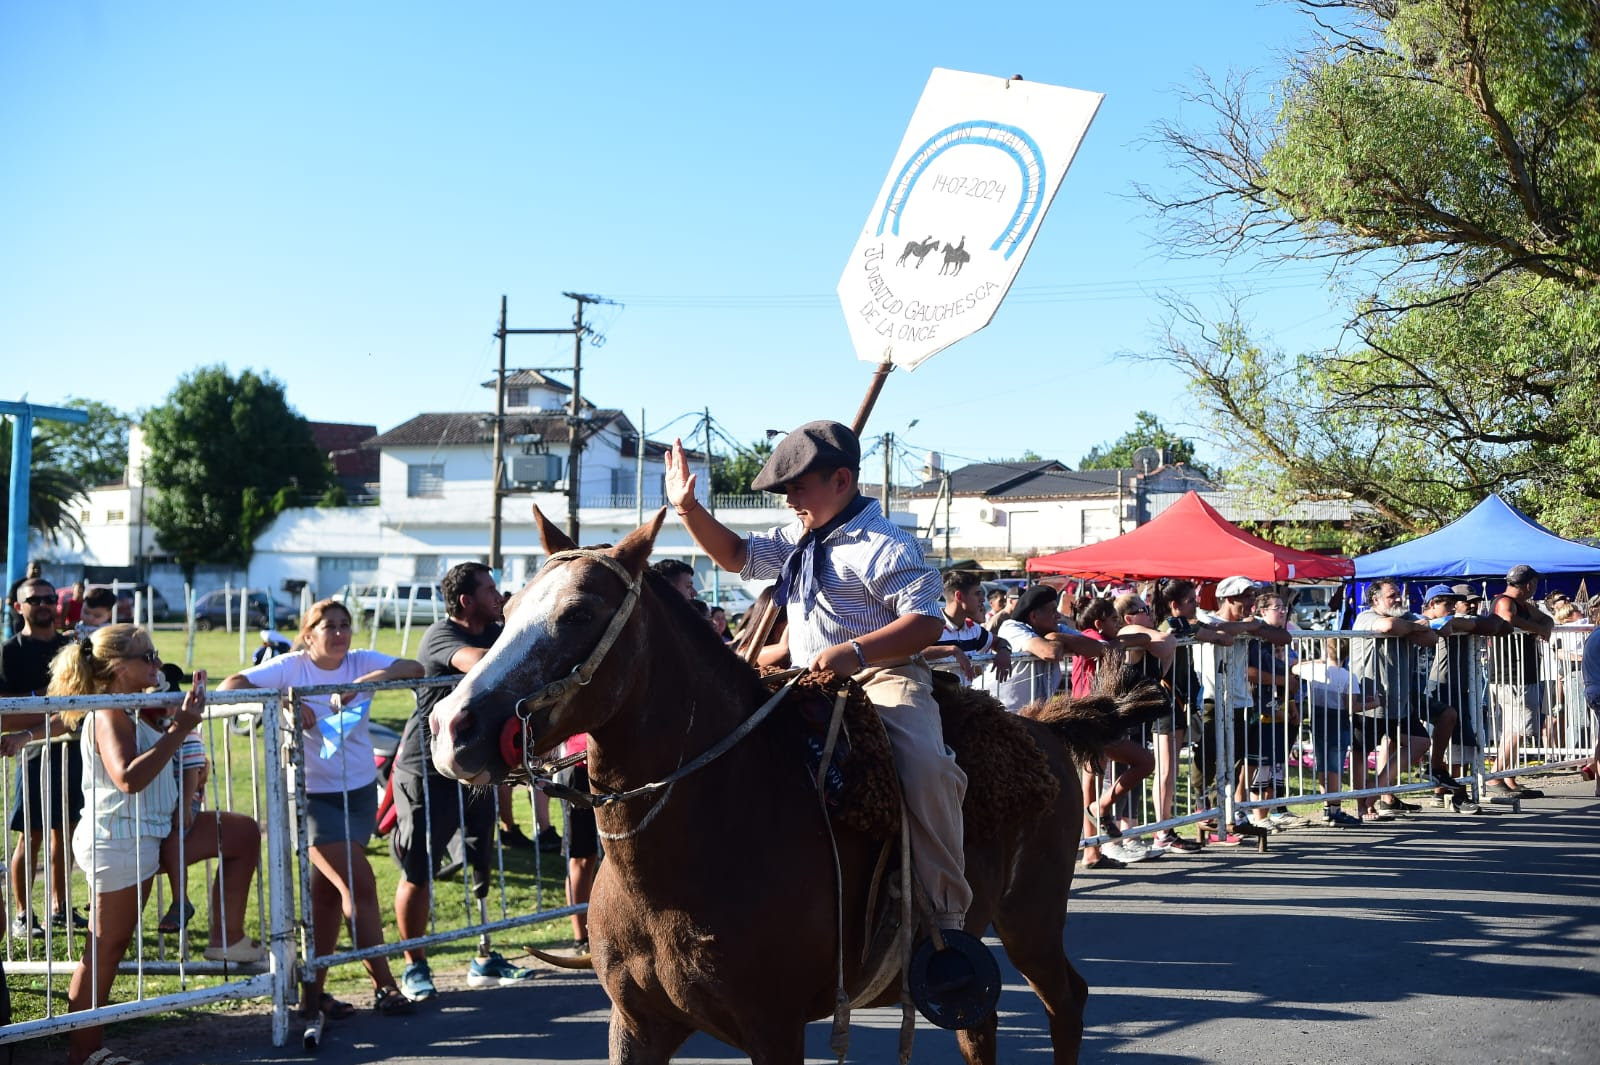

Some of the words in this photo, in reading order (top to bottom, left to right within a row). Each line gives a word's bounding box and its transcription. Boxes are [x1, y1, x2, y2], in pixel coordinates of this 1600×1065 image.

[864, 242, 903, 315] JUVENTUD
[904, 281, 1000, 322] GAUCHESCA
[859, 300, 881, 324] DE
[874, 318, 895, 338] LA
[897, 324, 940, 342] ONCE
